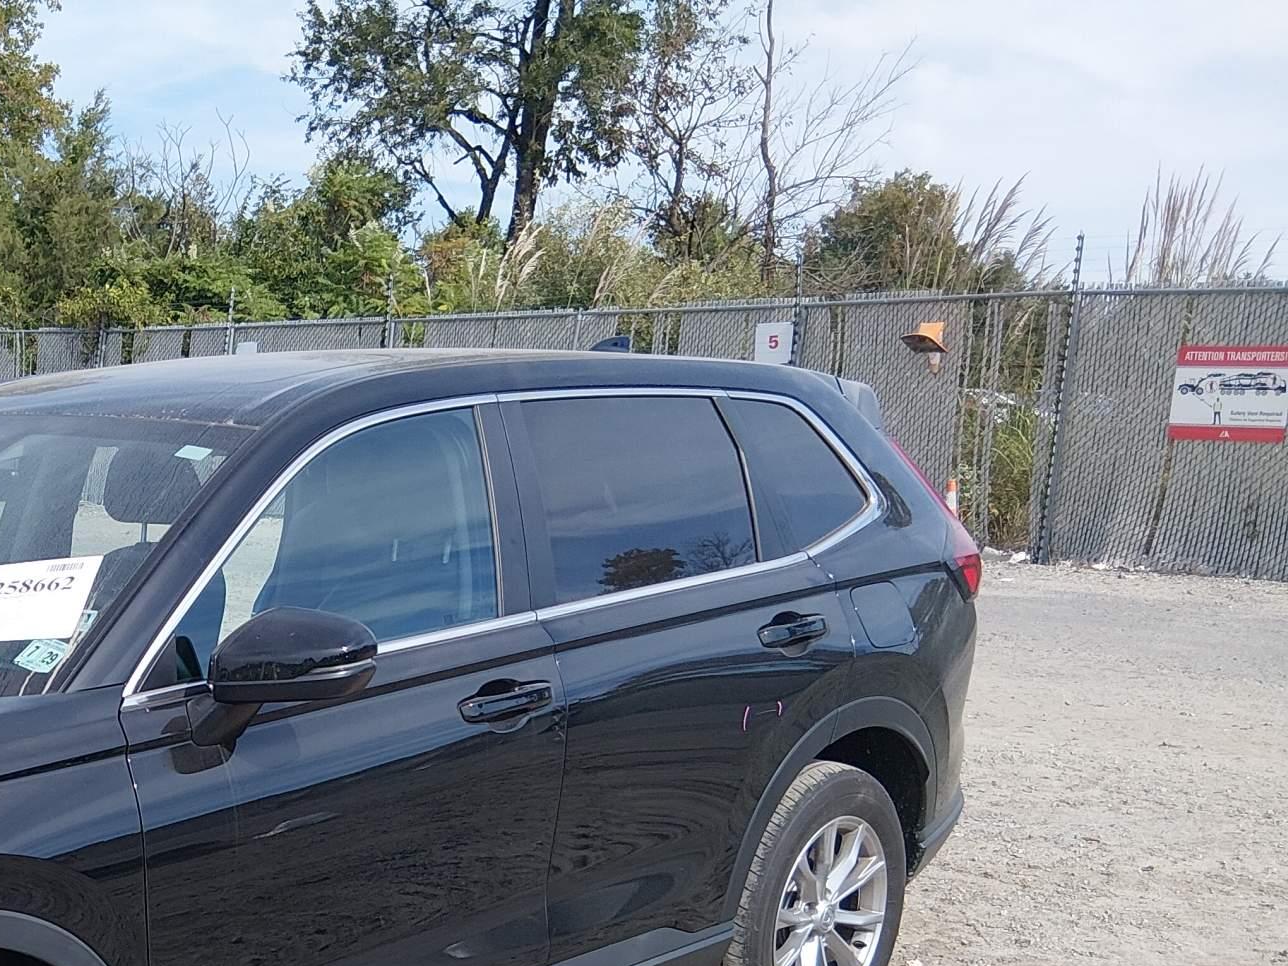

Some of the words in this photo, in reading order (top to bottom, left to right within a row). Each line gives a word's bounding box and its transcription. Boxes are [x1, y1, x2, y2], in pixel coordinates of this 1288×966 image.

[768, 334, 779, 350] 5
[1184, 351, 1225, 361] ATTENTION
[41, 651, 59, 665] 29
